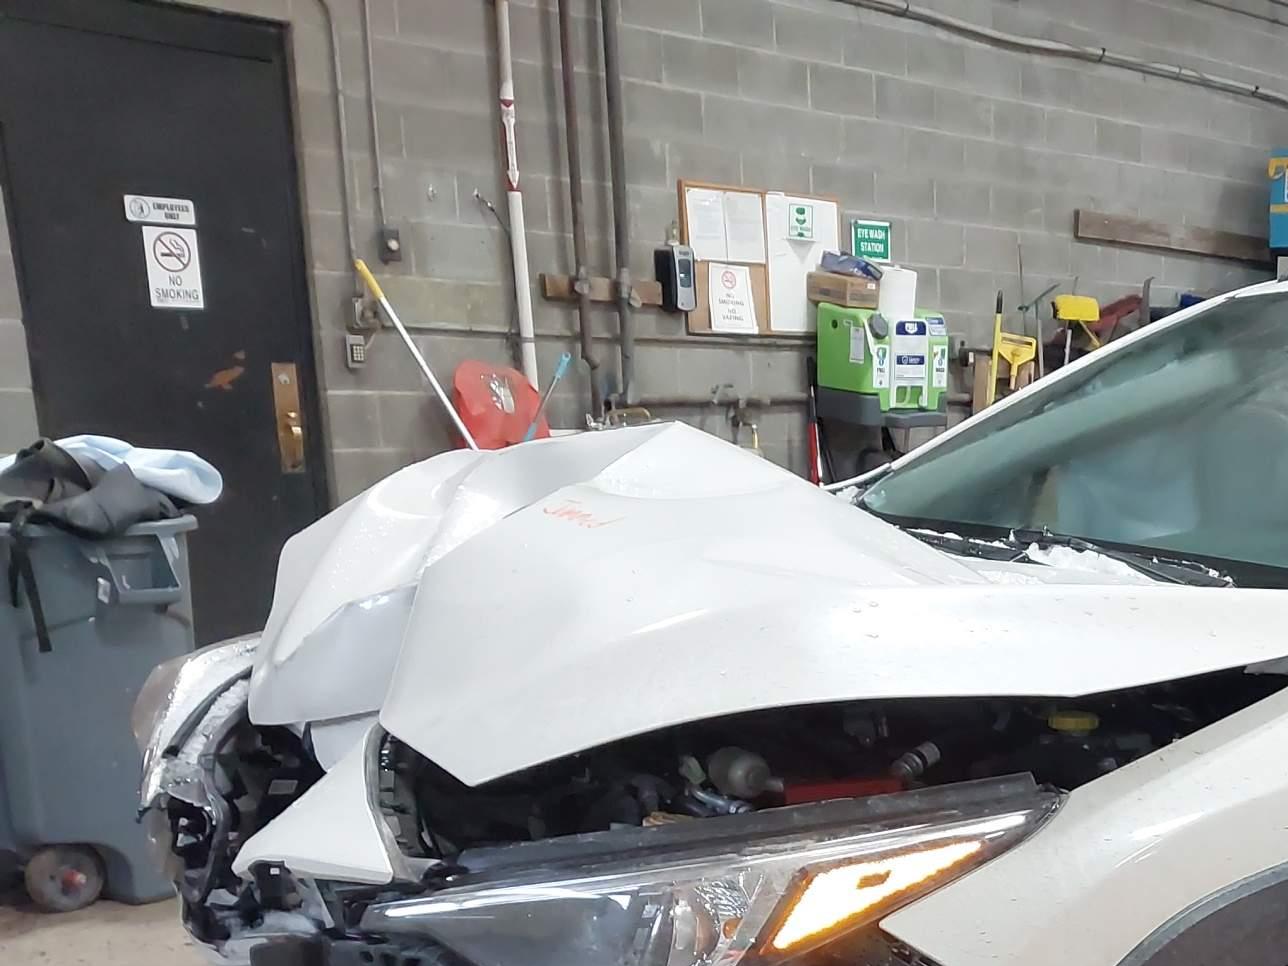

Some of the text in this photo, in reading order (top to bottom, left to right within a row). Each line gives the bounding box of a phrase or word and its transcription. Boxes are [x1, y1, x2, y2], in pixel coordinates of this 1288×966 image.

[860, 241, 885, 253] STATION
[168, 274, 183, 287] NO
[154, 287, 199, 300] SMOKING
